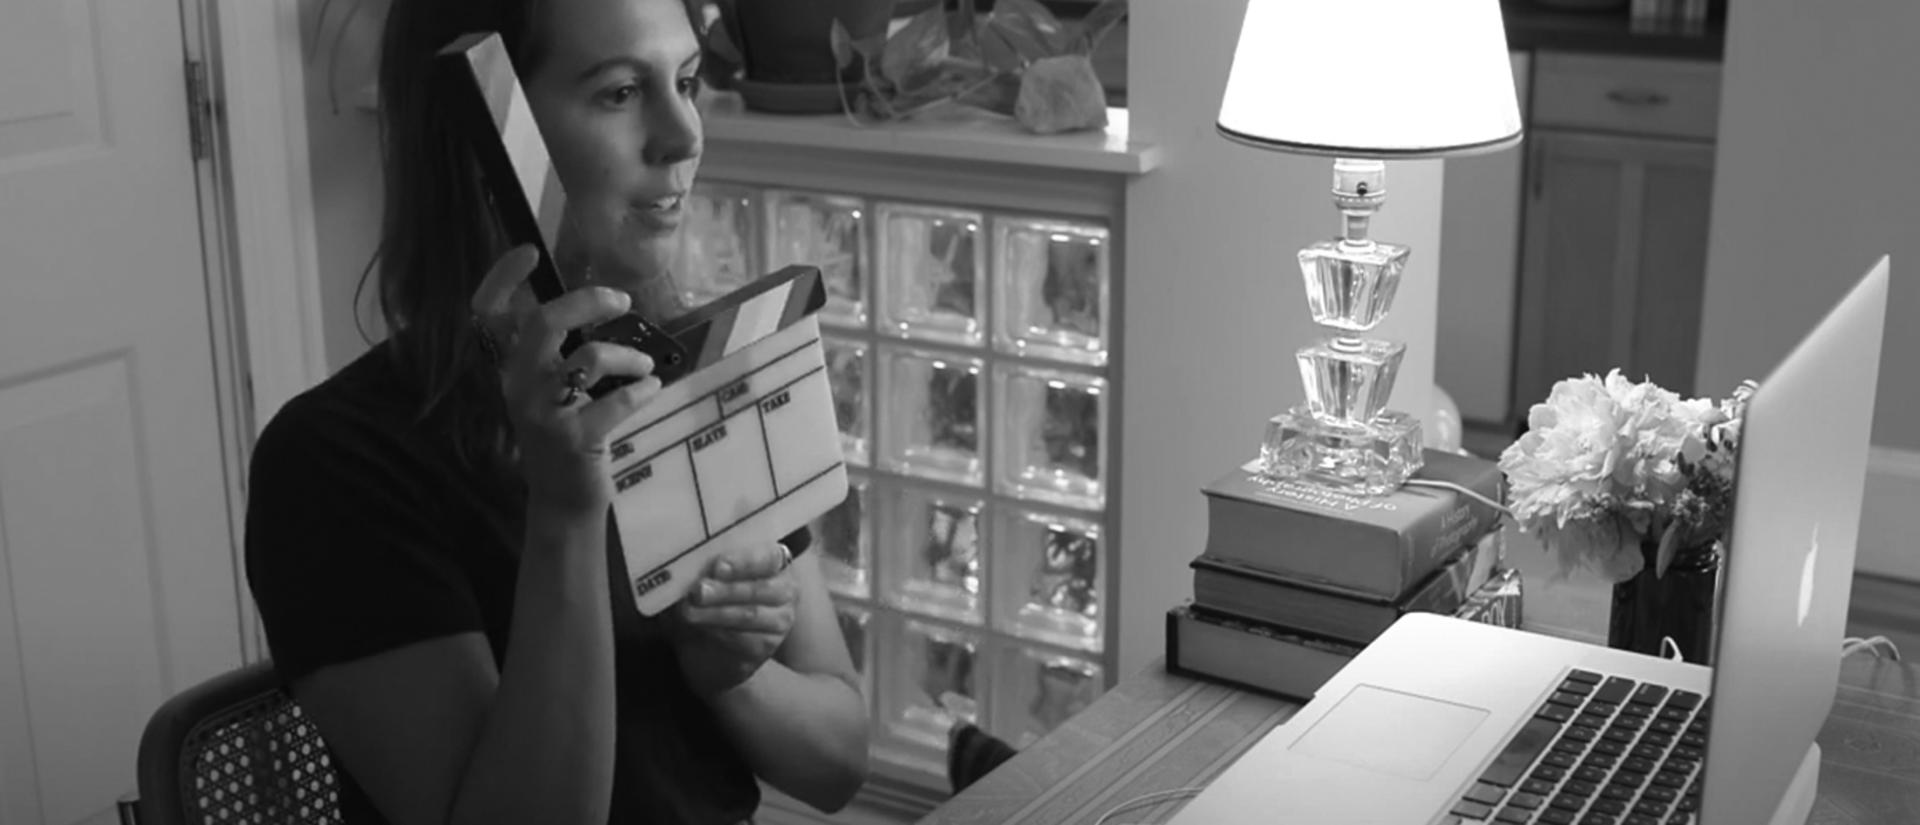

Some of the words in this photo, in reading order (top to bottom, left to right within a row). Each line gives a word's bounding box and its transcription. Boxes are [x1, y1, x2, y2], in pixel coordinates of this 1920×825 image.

[762, 391, 791, 414] TAKE
[692, 425, 728, 453] SLATE
[615, 463, 653, 494] SCENE
